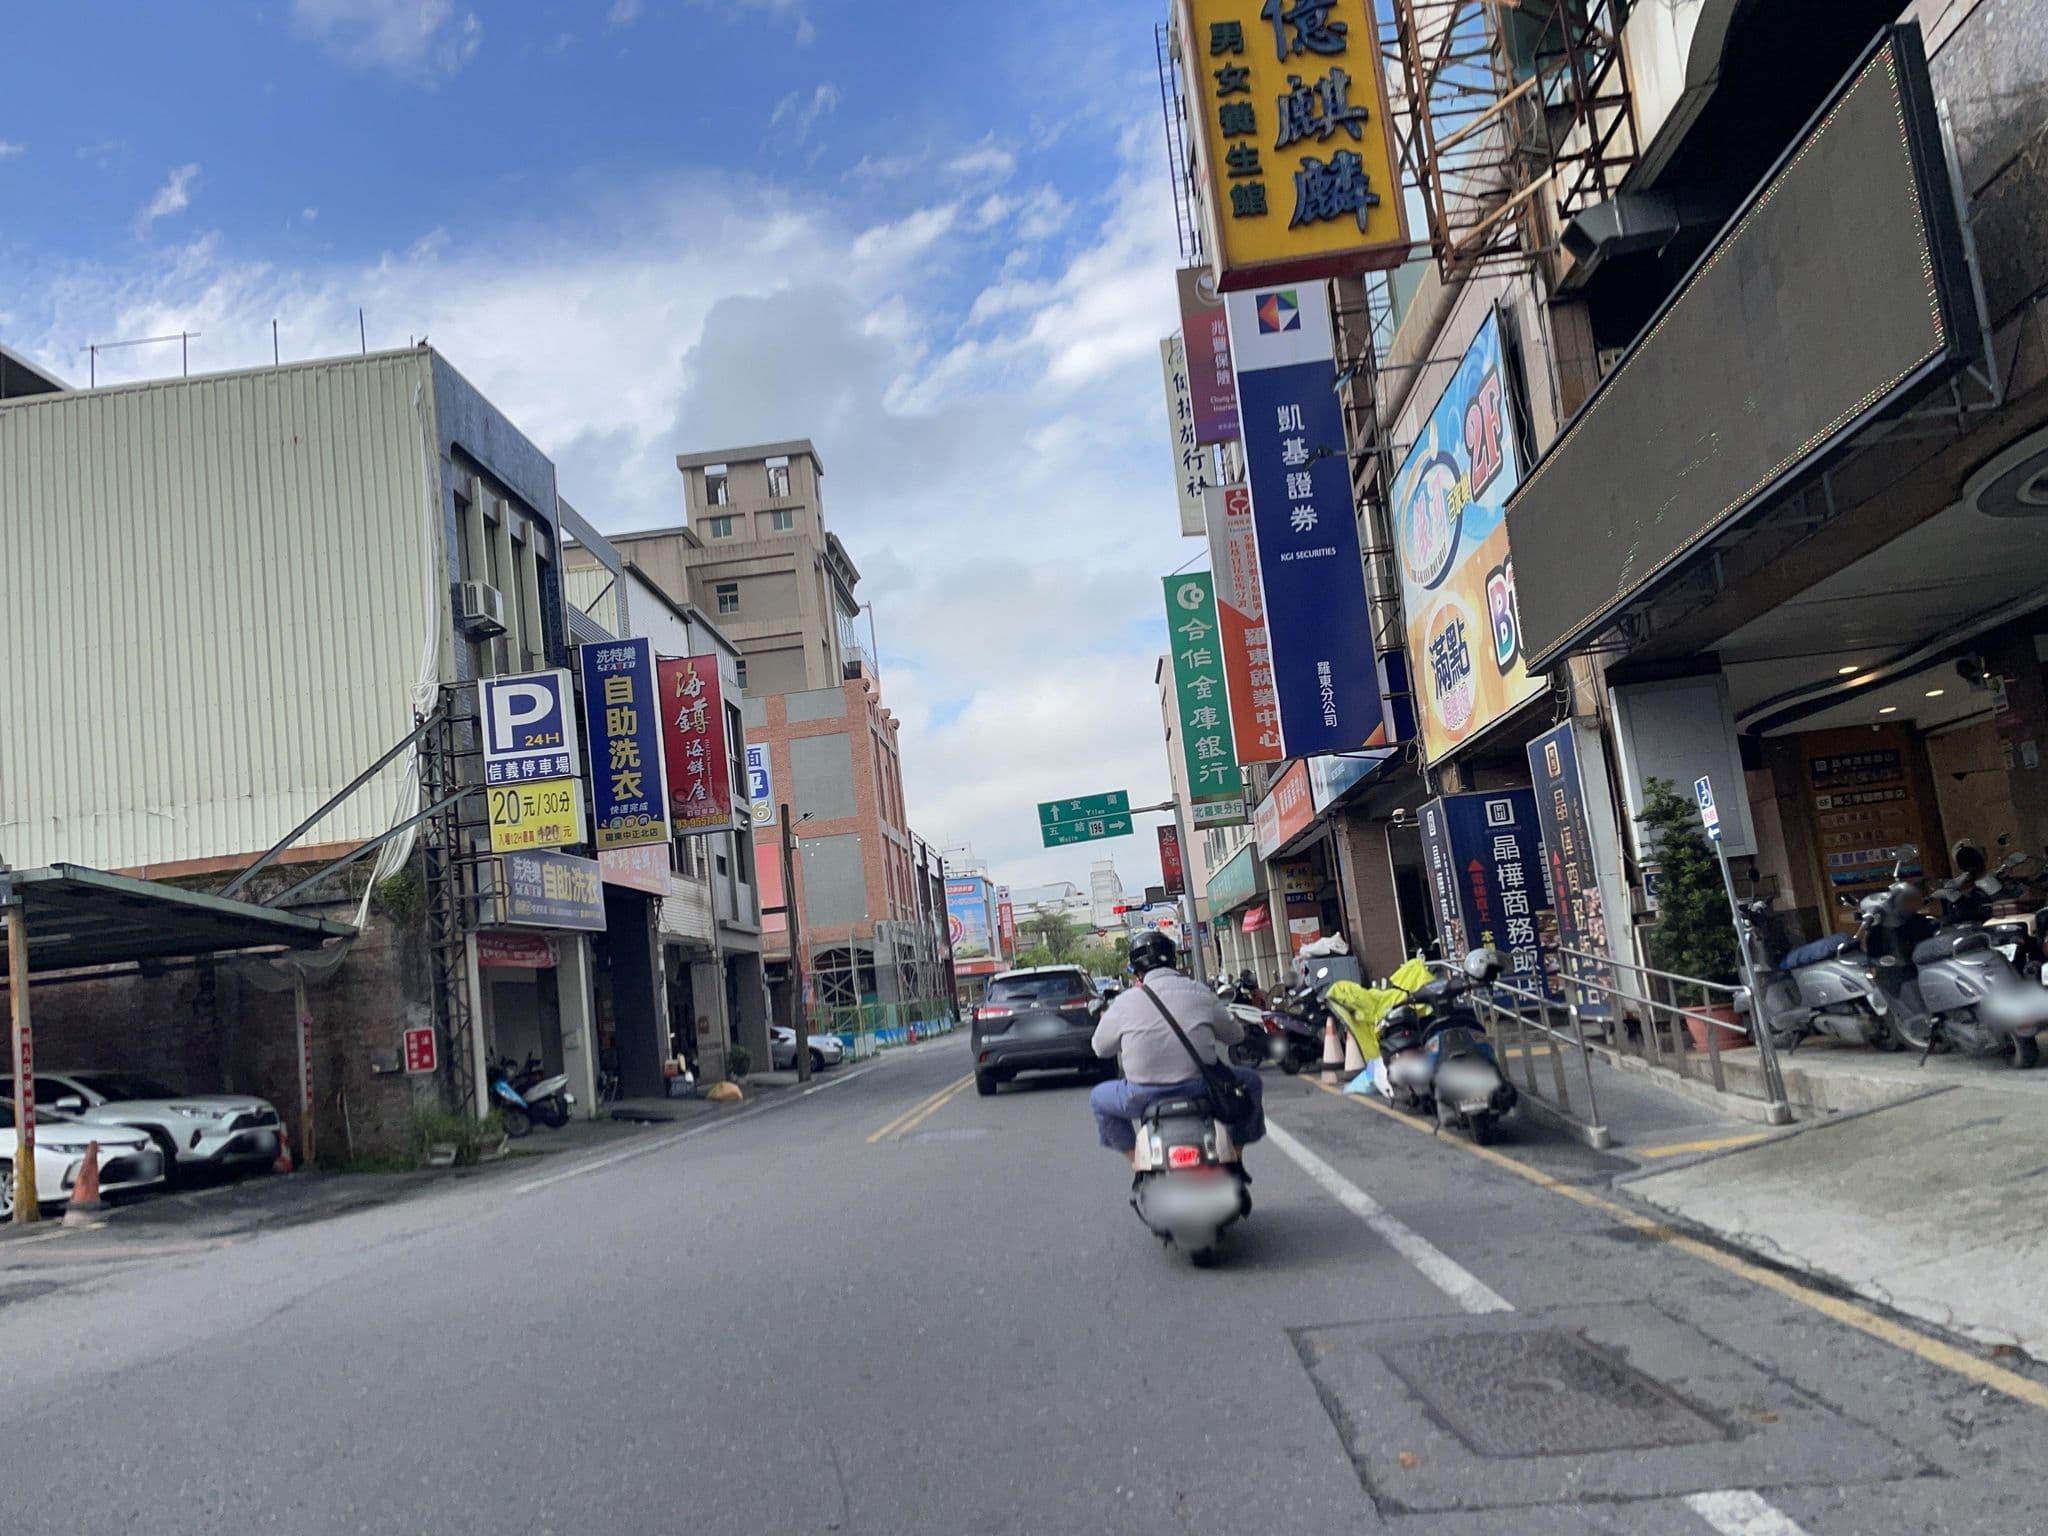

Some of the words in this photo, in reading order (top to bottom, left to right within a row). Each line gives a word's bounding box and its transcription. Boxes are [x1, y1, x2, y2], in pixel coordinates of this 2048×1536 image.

[1465, 372, 1500, 492] 2F
[1277, 404, 1318, 533] 凱基證券
[1280, 552, 1294, 562] KGI
[1296, 547, 1337, 560] SECURITIES
[1178, 617, 1229, 785] 合作金庫銀行
[1244, 627, 1281, 749] 羅東就業中心
[1317, 661, 1338, 727] 羅東分公司
[492, 683, 554, 750] P
[524, 732, 560, 747] 24H
[604, 674, 645, 801] 自助洗衣
[488, 755, 570, 782] 信義停車場
[492, 790, 570, 825] 20元/30分
[610, 802, 649, 815] 快速完成
[1193, 802, 1243, 822] 北羅東分行
[542, 861, 601, 905] 自助洗衣
